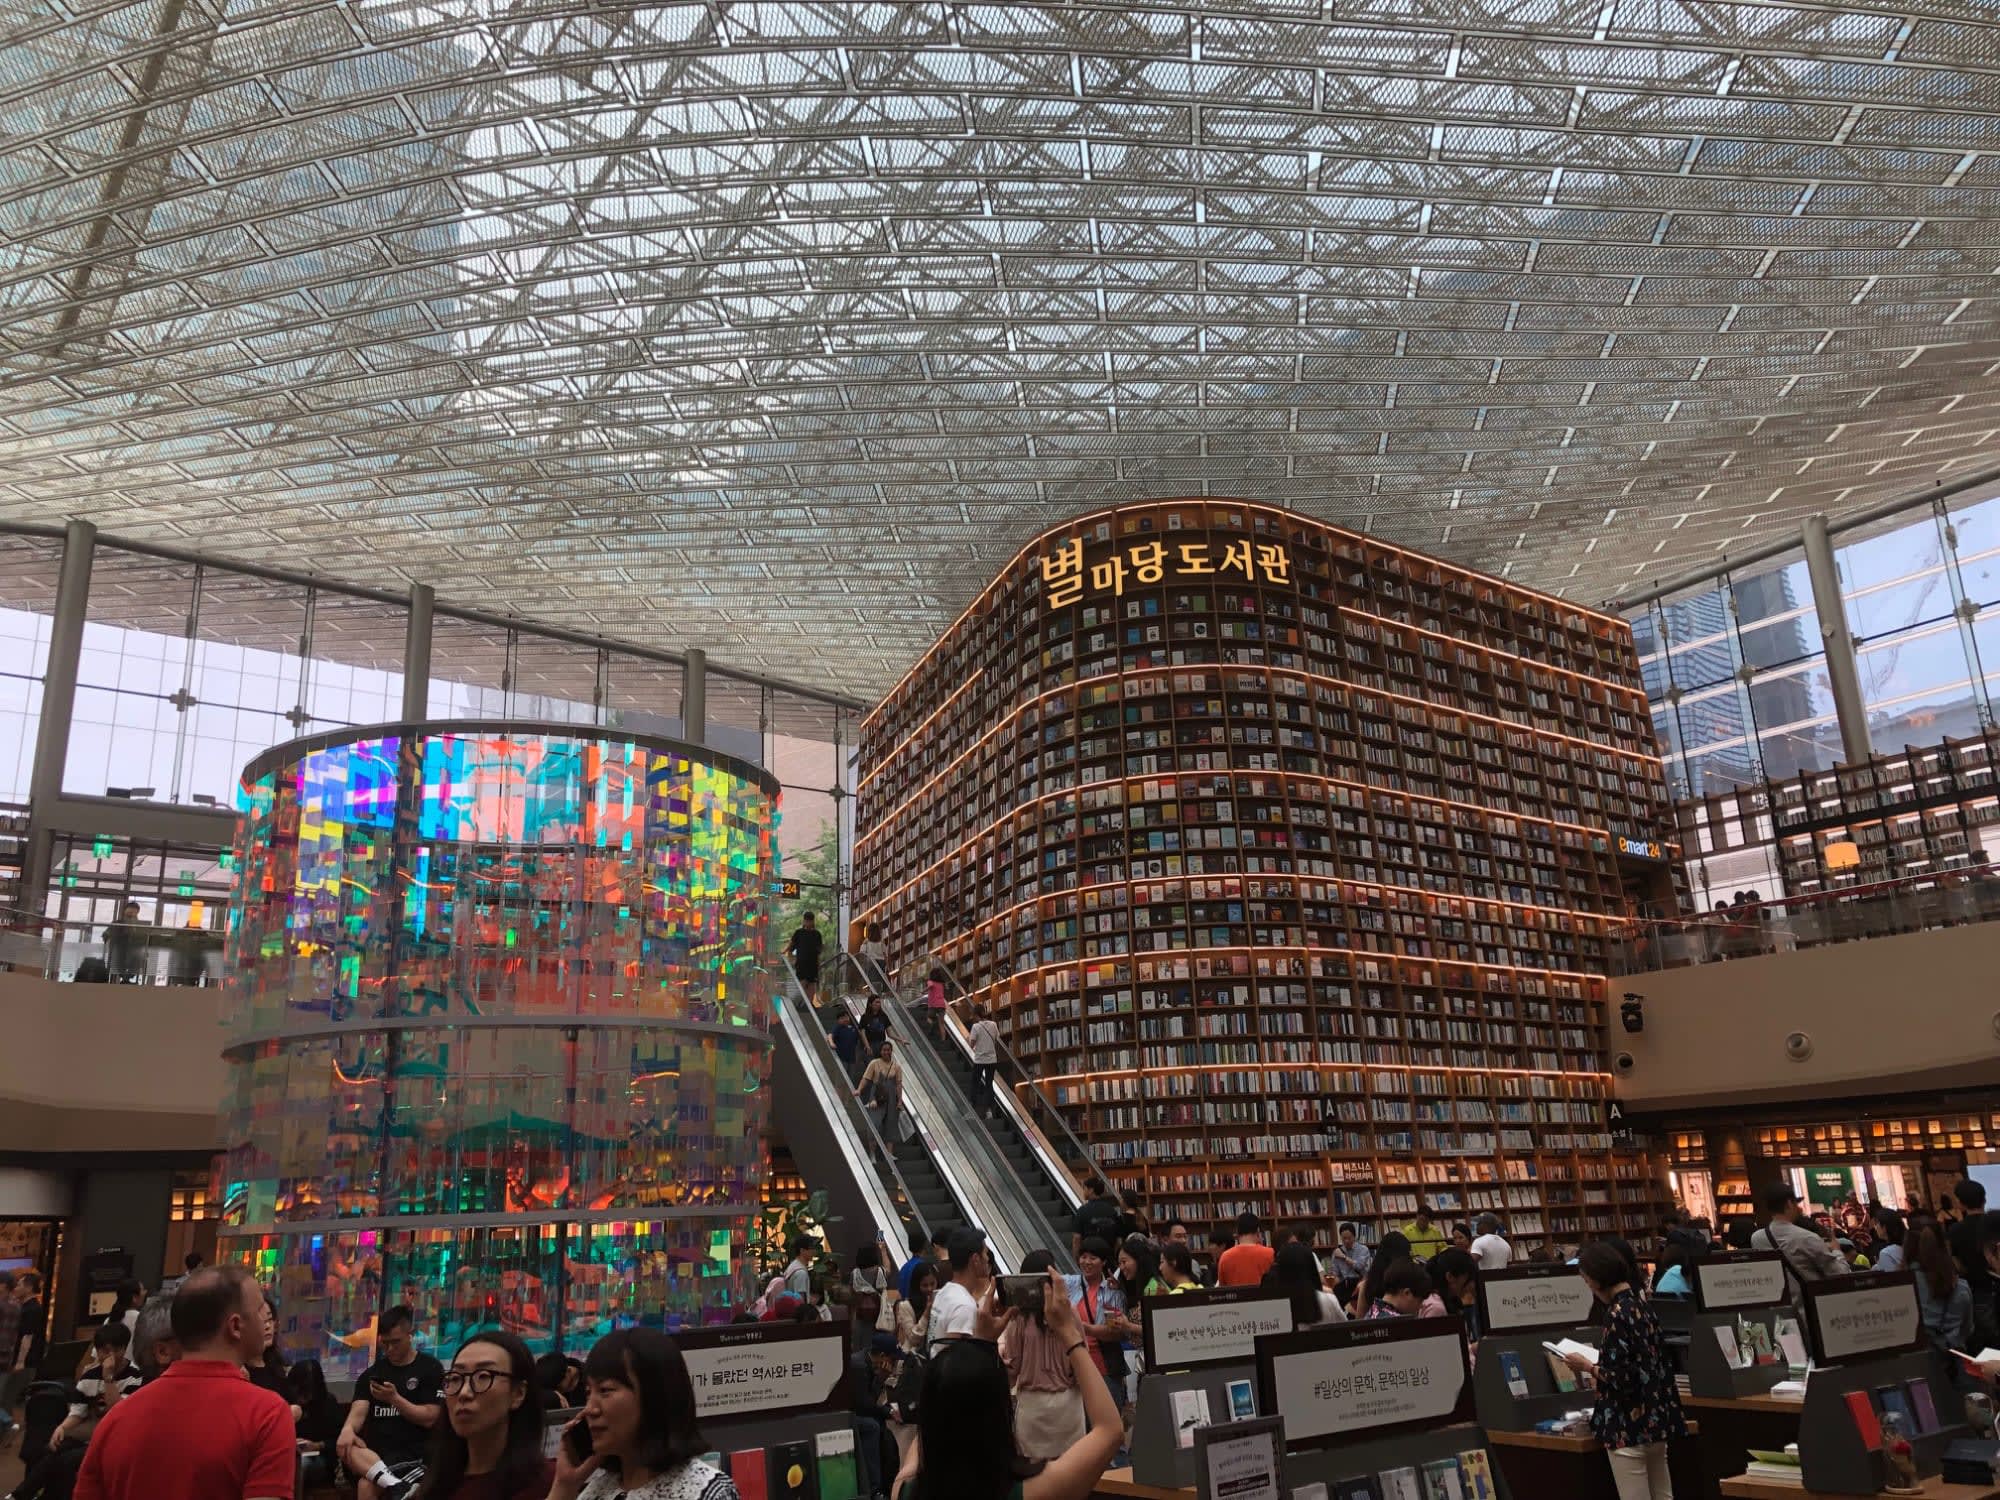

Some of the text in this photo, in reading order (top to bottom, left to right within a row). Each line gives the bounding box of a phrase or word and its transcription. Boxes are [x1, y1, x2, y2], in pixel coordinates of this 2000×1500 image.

[1326, 1099, 1335, 1117] A
[1610, 1103, 1622, 1119] A
[1343, 1161, 1373, 1172] 비즈니스
[712, 1368, 748, 1386] 몰랐던
[752, 1366, 789, 1382] 역사와
[791, 1361, 815, 1377] 문학
[1314, 1375, 1353, 1400] #일상의
[1378, 1369, 1409, 1392] 문학의
[1409, 1366, 1430, 1387] 일상
